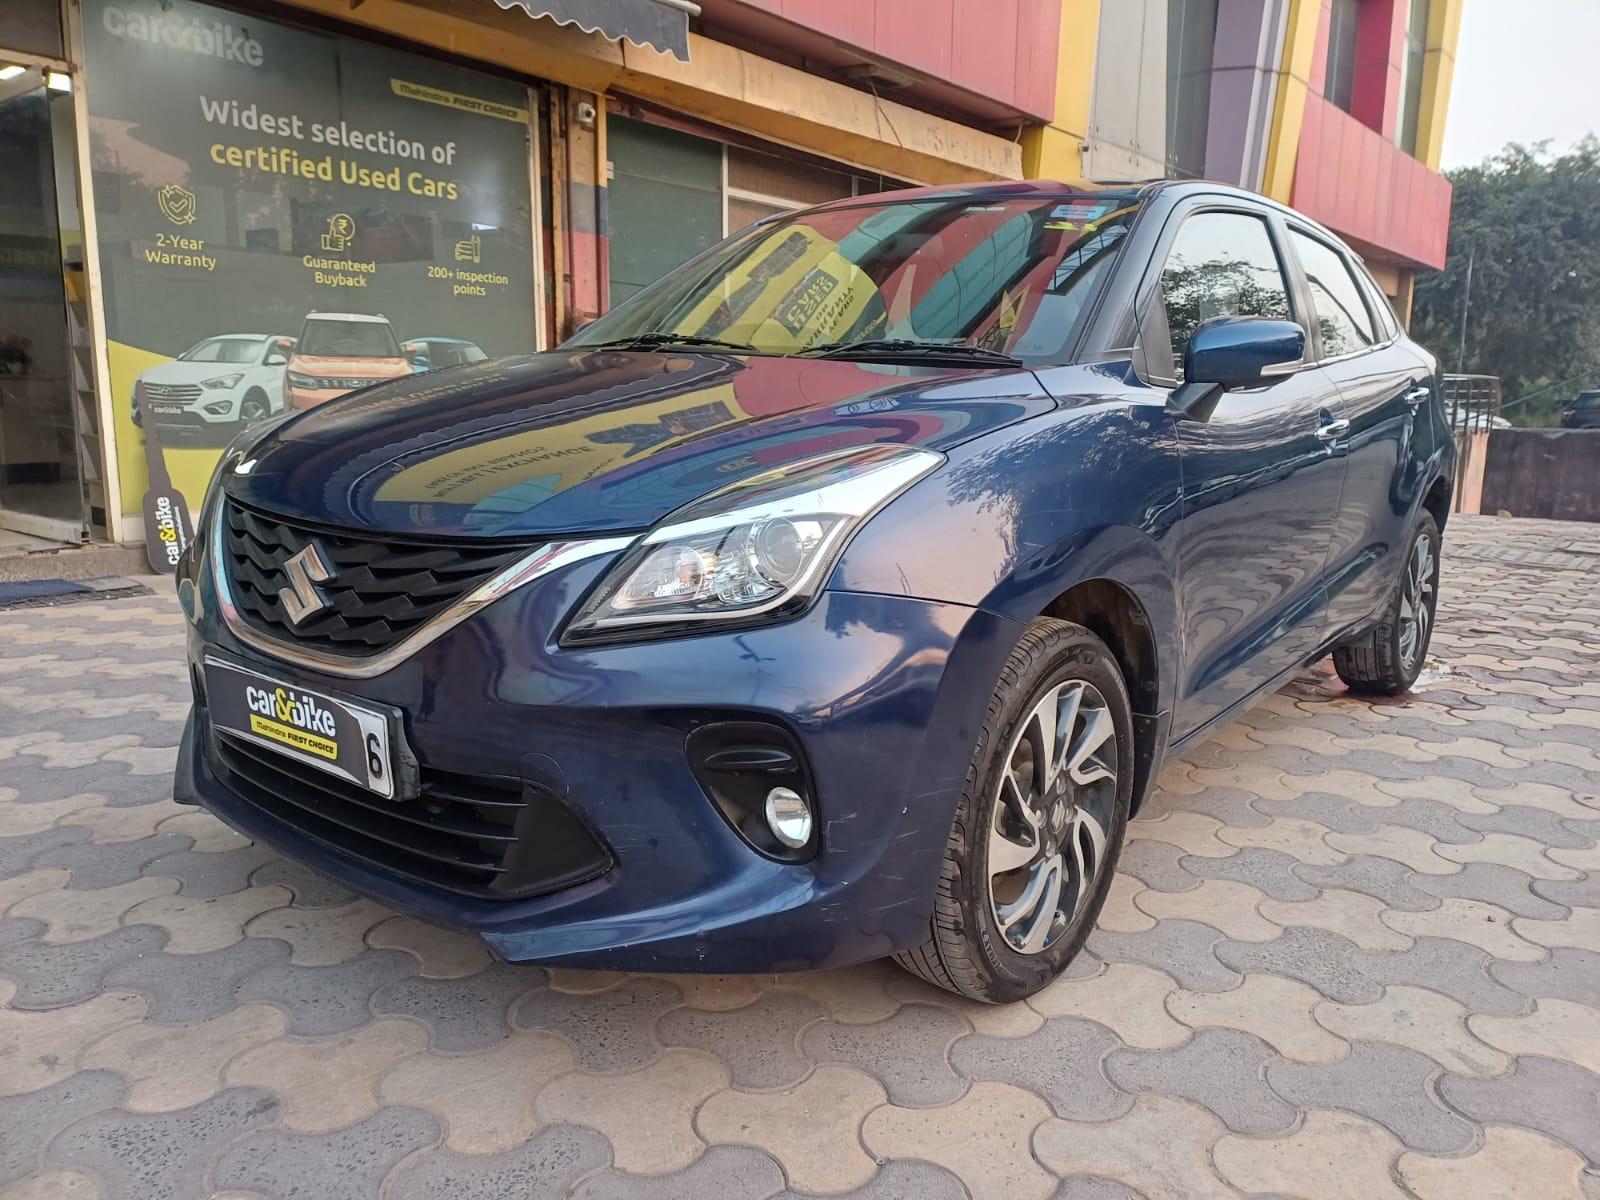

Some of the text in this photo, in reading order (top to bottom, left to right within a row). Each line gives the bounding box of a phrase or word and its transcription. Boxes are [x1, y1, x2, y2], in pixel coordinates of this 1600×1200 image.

[103, 6, 264, 67] car&bike
[453, 97, 482, 111] FIRST
[483, 104, 518, 118] CHOICE
[200, 95, 456, 165] Widest selection of
[210, 143, 458, 201] certified Used Cars
[156, 233, 204, 250] 2-Year
[145, 249, 216, 271] Warranty
[303, 255, 376, 273] Guaranteed
[315, 271, 367, 287] Buyback
[427, 266, 509, 285] 200+ inspection
[453, 283, 486, 296] points
[155, 496, 180, 565] car&bike
[246, 686, 336, 737] car&bike
[256, 721, 334, 754] Mahindra FIRST CHOICE
[366, 732, 384, 779] 6
